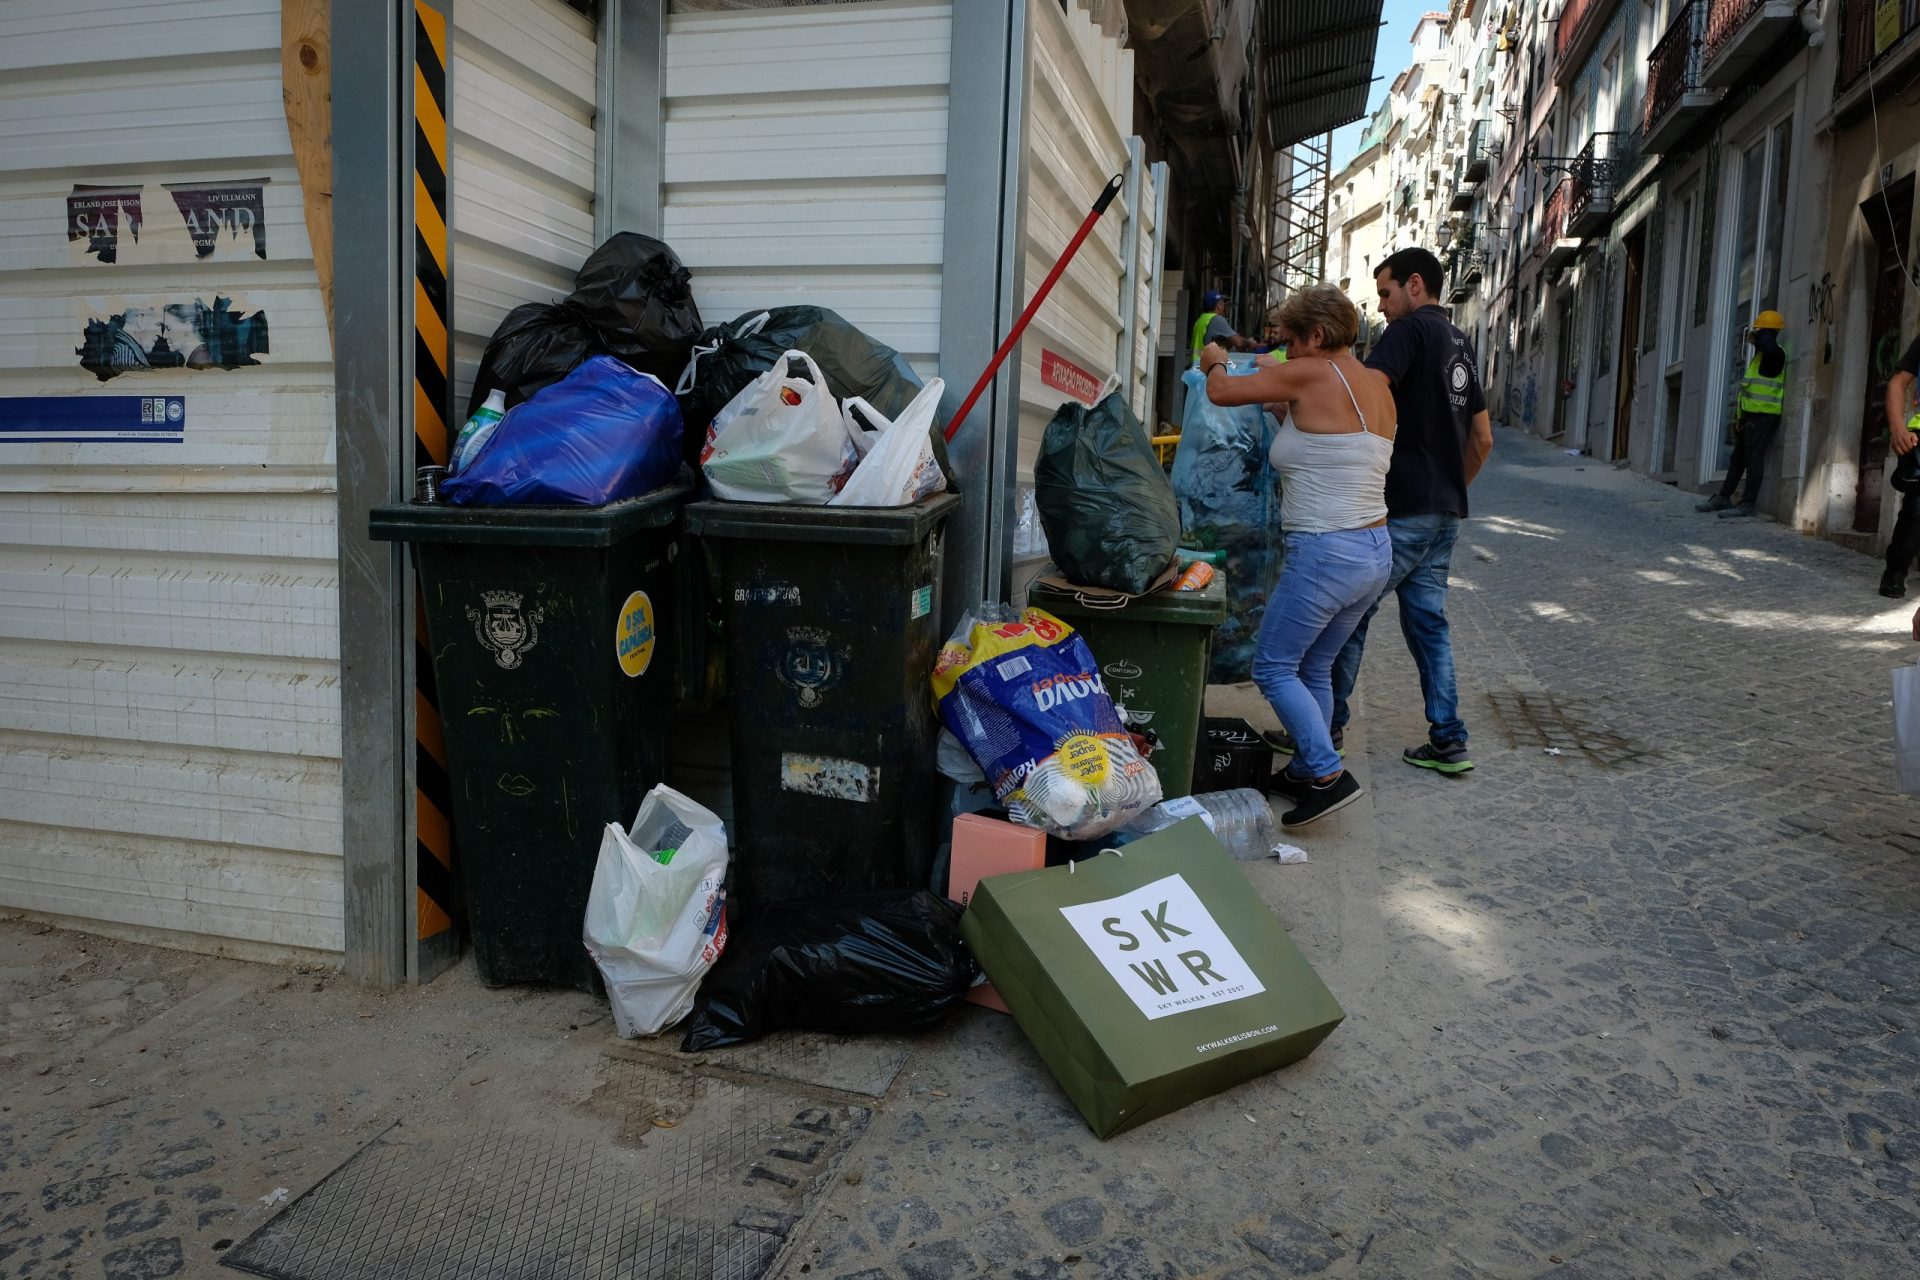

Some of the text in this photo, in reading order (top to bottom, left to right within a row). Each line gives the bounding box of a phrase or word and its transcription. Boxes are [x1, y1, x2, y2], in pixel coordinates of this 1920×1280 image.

[74, 201, 101, 209] ERLAND
[208, 193, 256, 203] LIV ULLMANN
[1070, 744, 1097, 760] super
[1081, 762, 1104, 777] super
[1157, 984, 1245, 1011] SKY WALKER EST 2007
[1196, 1024, 1279, 1053] SKYWALKERLISBON.COM
